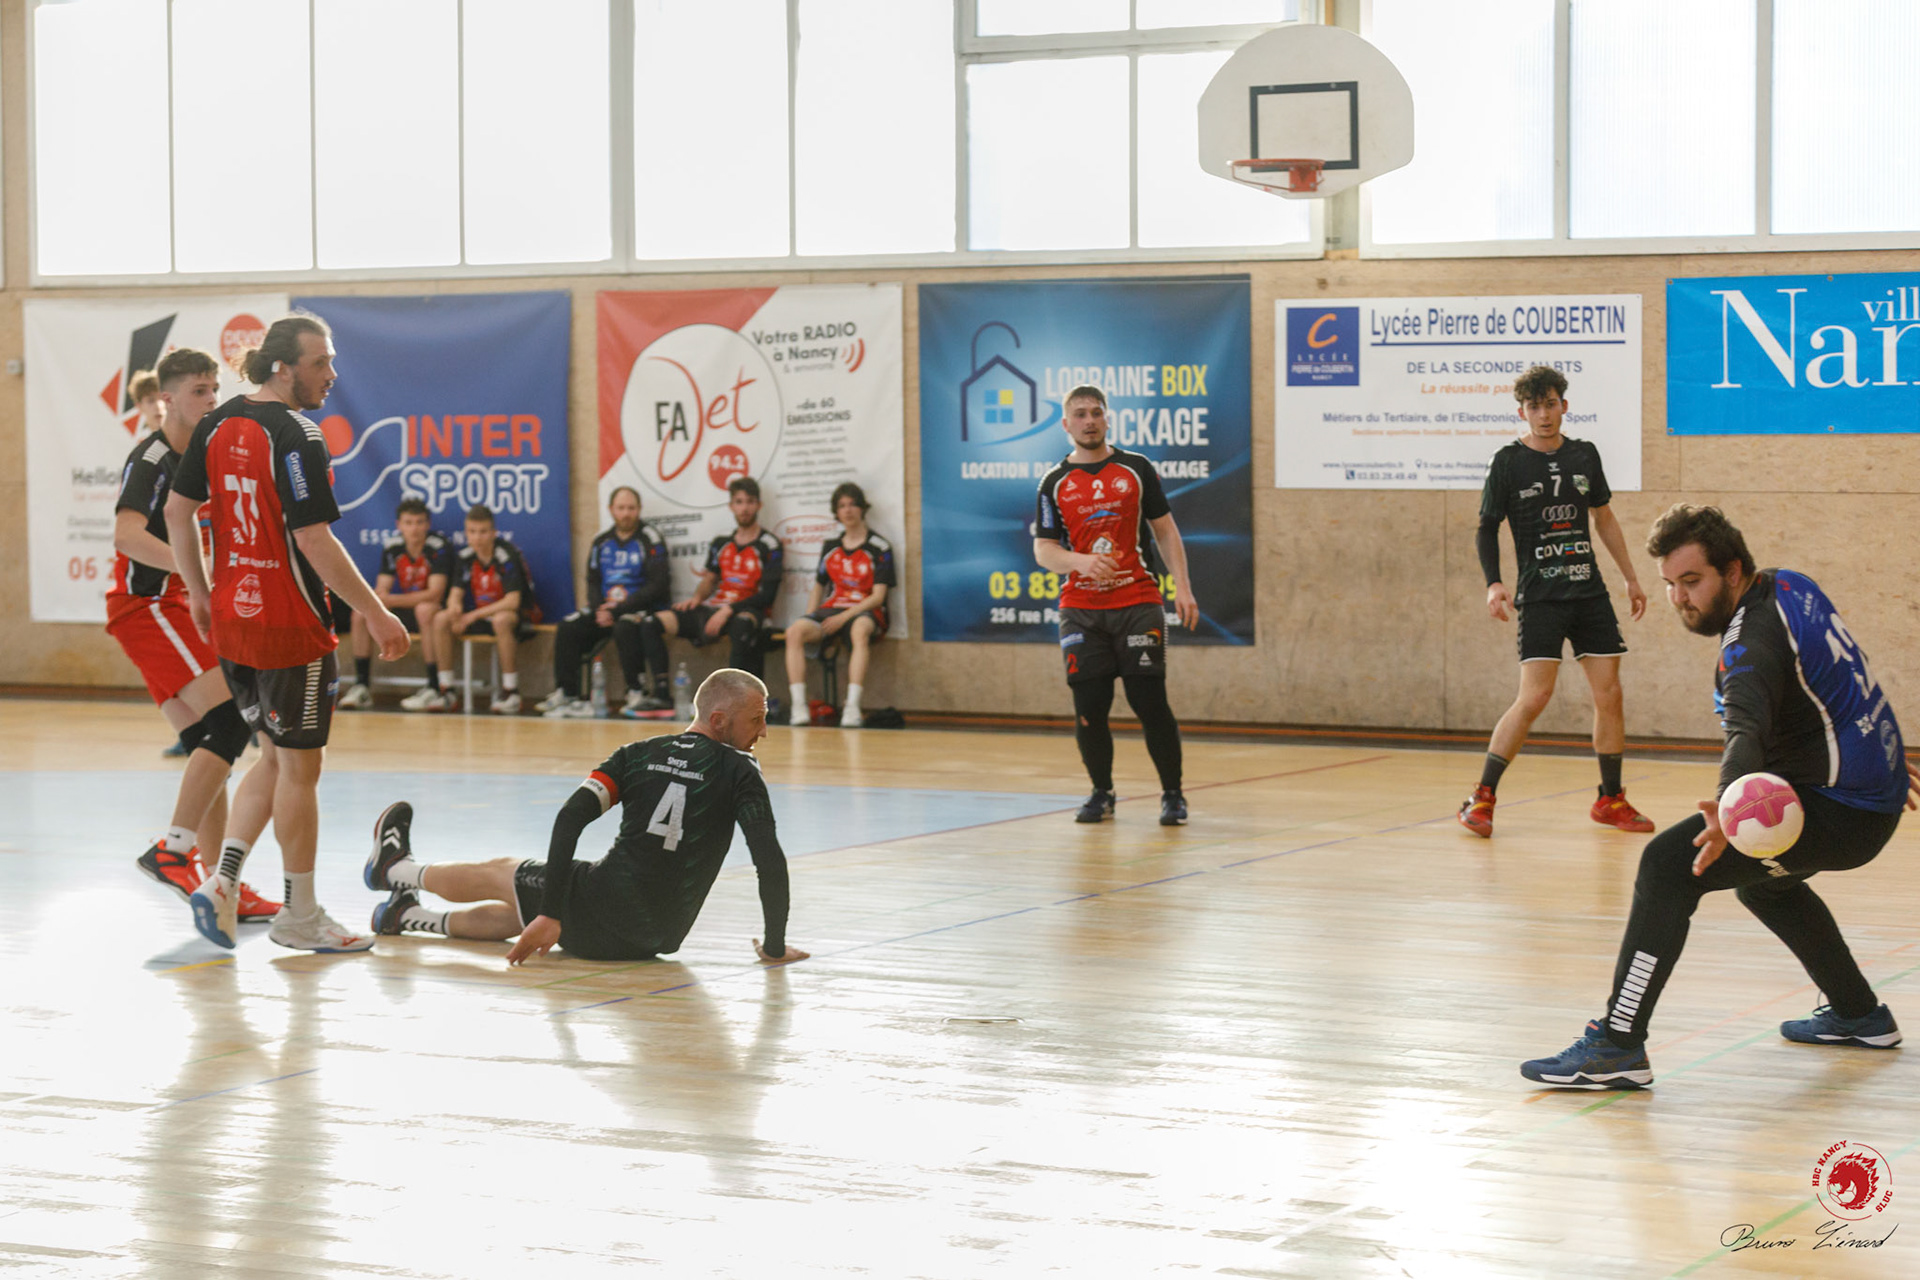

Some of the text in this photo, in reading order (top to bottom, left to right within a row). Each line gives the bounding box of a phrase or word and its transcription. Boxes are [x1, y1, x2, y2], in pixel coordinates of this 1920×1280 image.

[752, 321, 857, 345] Votre RADIO
[1371, 305, 1626, 343] Lycée Pierre de COUBERTIN
[788, 346, 838, 363] Nancy
[1407, 361, 1426, 373] DE
[1431, 361, 1449, 373] LA
[1453, 361, 1524, 373] SECONDE
[1553, 361, 1583, 373] BTS
[1162, 365, 1208, 396] BOX
[1421, 383, 1436, 394] La
[1439, 381, 1490, 394] réussite
[1323, 411, 1363, 422] Métiers
[1366, 412, 1380, 422] du
[1435, 412, 1448, 422] de
[1566, 411, 1598, 425] Sport
[406, 414, 542, 457] INTER
[961, 462, 1029, 479] LOCATION
[400, 463, 549, 514] SPORT
[1092, 479, 1105, 500] 2
[1551, 474, 1562, 497] 7
[1535, 541, 1590, 559] COVECO
[68, 556, 98, 581] 06
[989, 571, 1021, 599] 03
[1028, 571, 1060, 599] 83
[990, 607, 1016, 623] 256
[1019, 609, 1042, 623] rue
[1068, 653, 1079, 674] 2
[646, 781, 687, 852] 4
